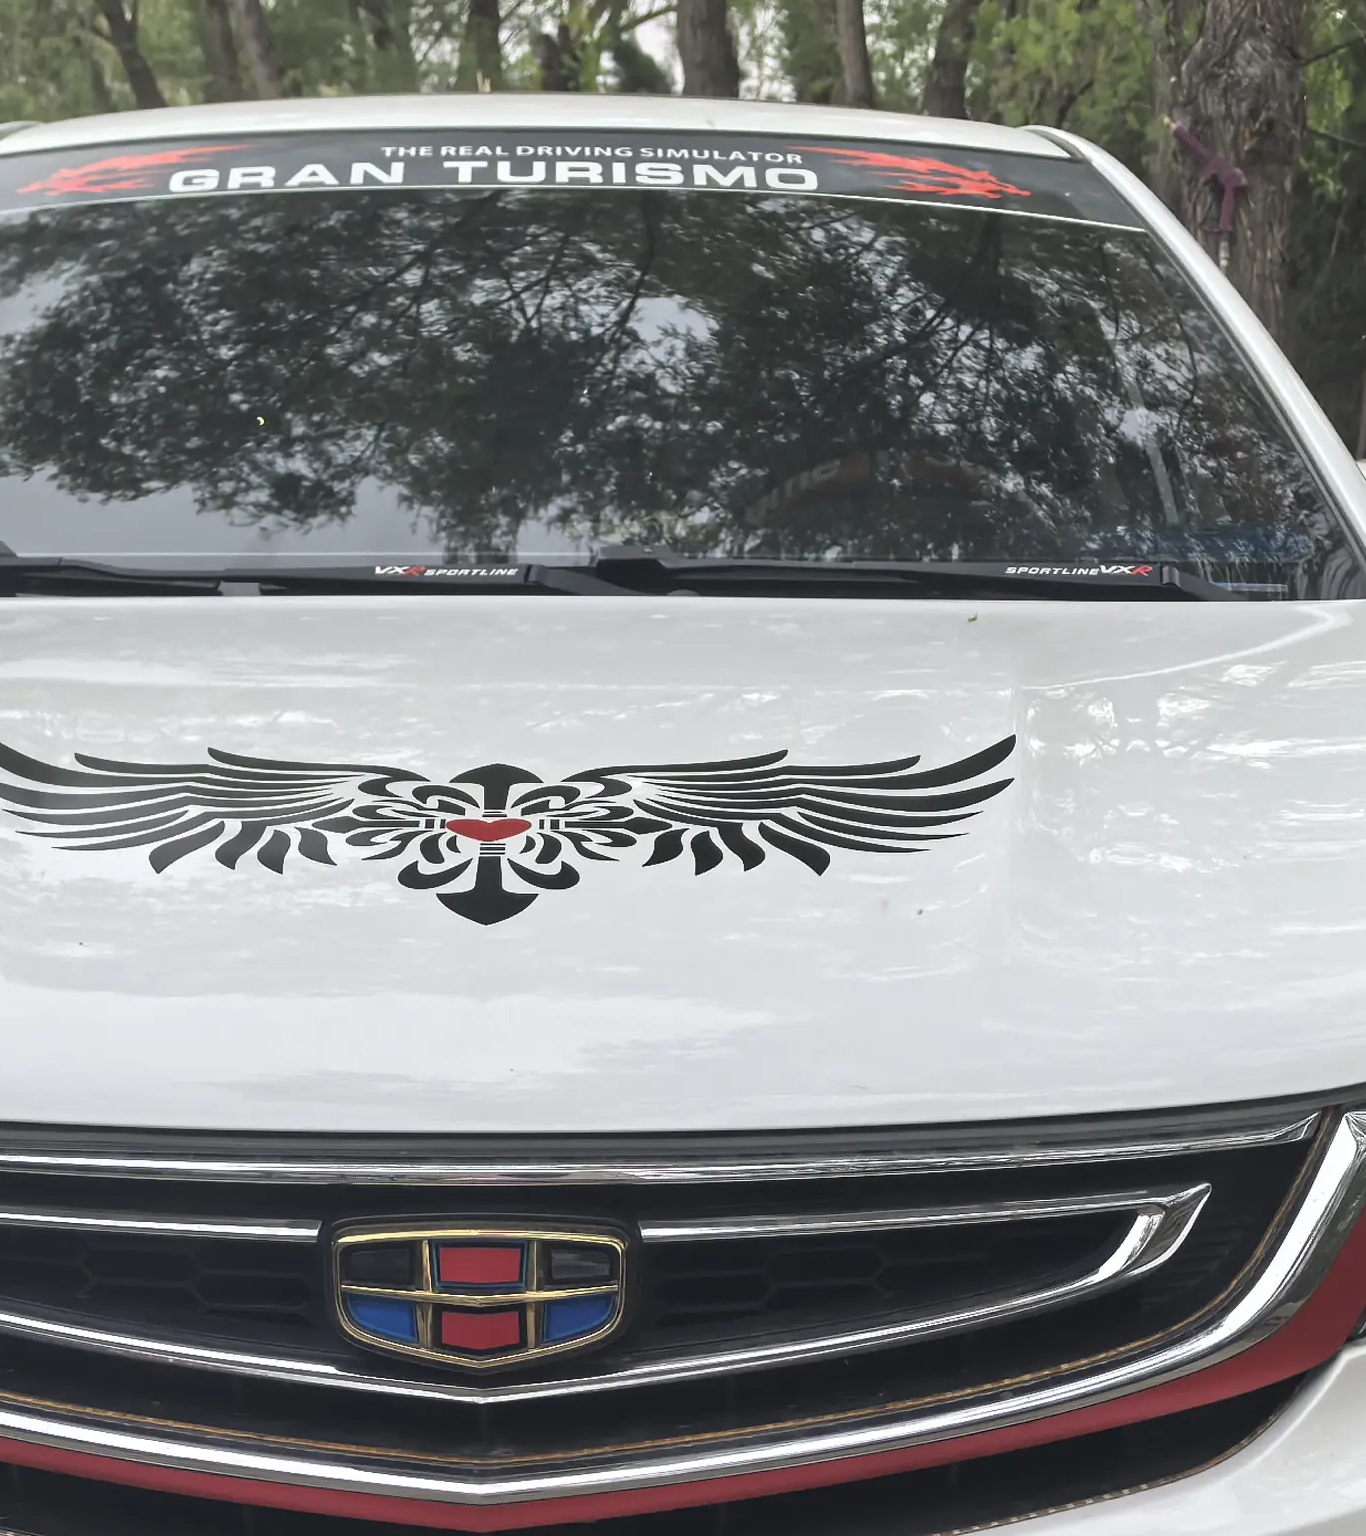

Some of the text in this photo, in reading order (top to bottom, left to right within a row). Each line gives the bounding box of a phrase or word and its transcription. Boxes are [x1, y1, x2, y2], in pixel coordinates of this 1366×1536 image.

[381, 145, 803, 164] THE REAL DRIVING SIMULATOR
[169, 161, 818, 193] GRAN TURISMO
[423, 568, 519, 576] SPORTLINE
